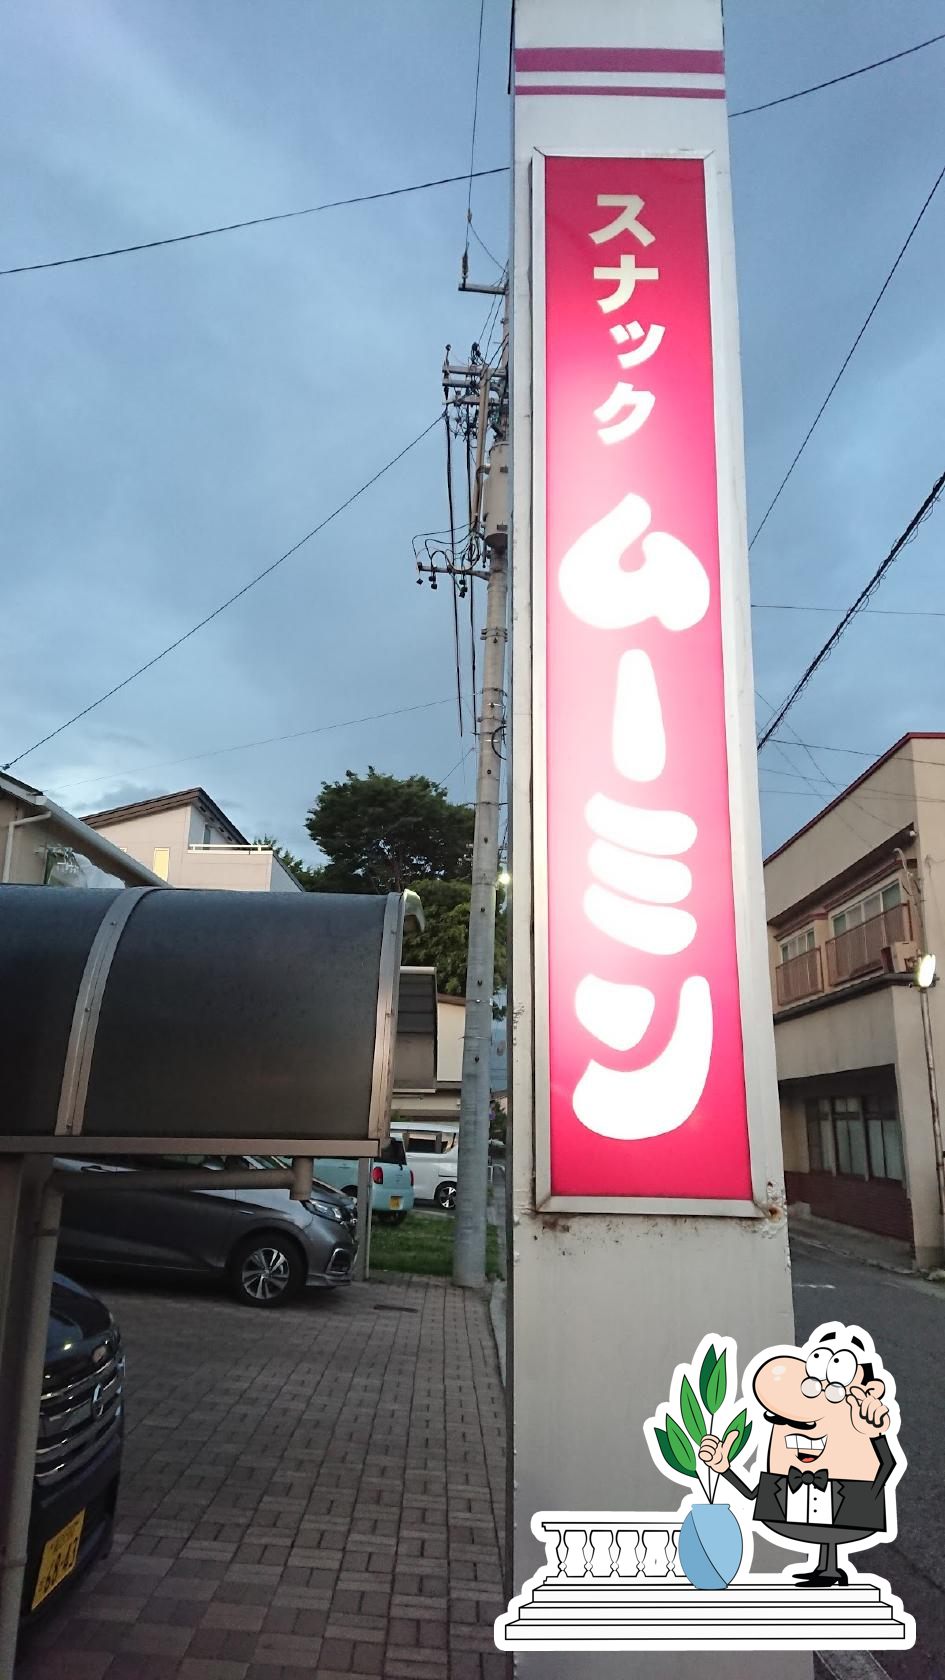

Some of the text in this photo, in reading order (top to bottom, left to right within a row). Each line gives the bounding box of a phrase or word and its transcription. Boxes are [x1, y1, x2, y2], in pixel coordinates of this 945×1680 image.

[558, 194, 713, 1140] スナック ムーミン
